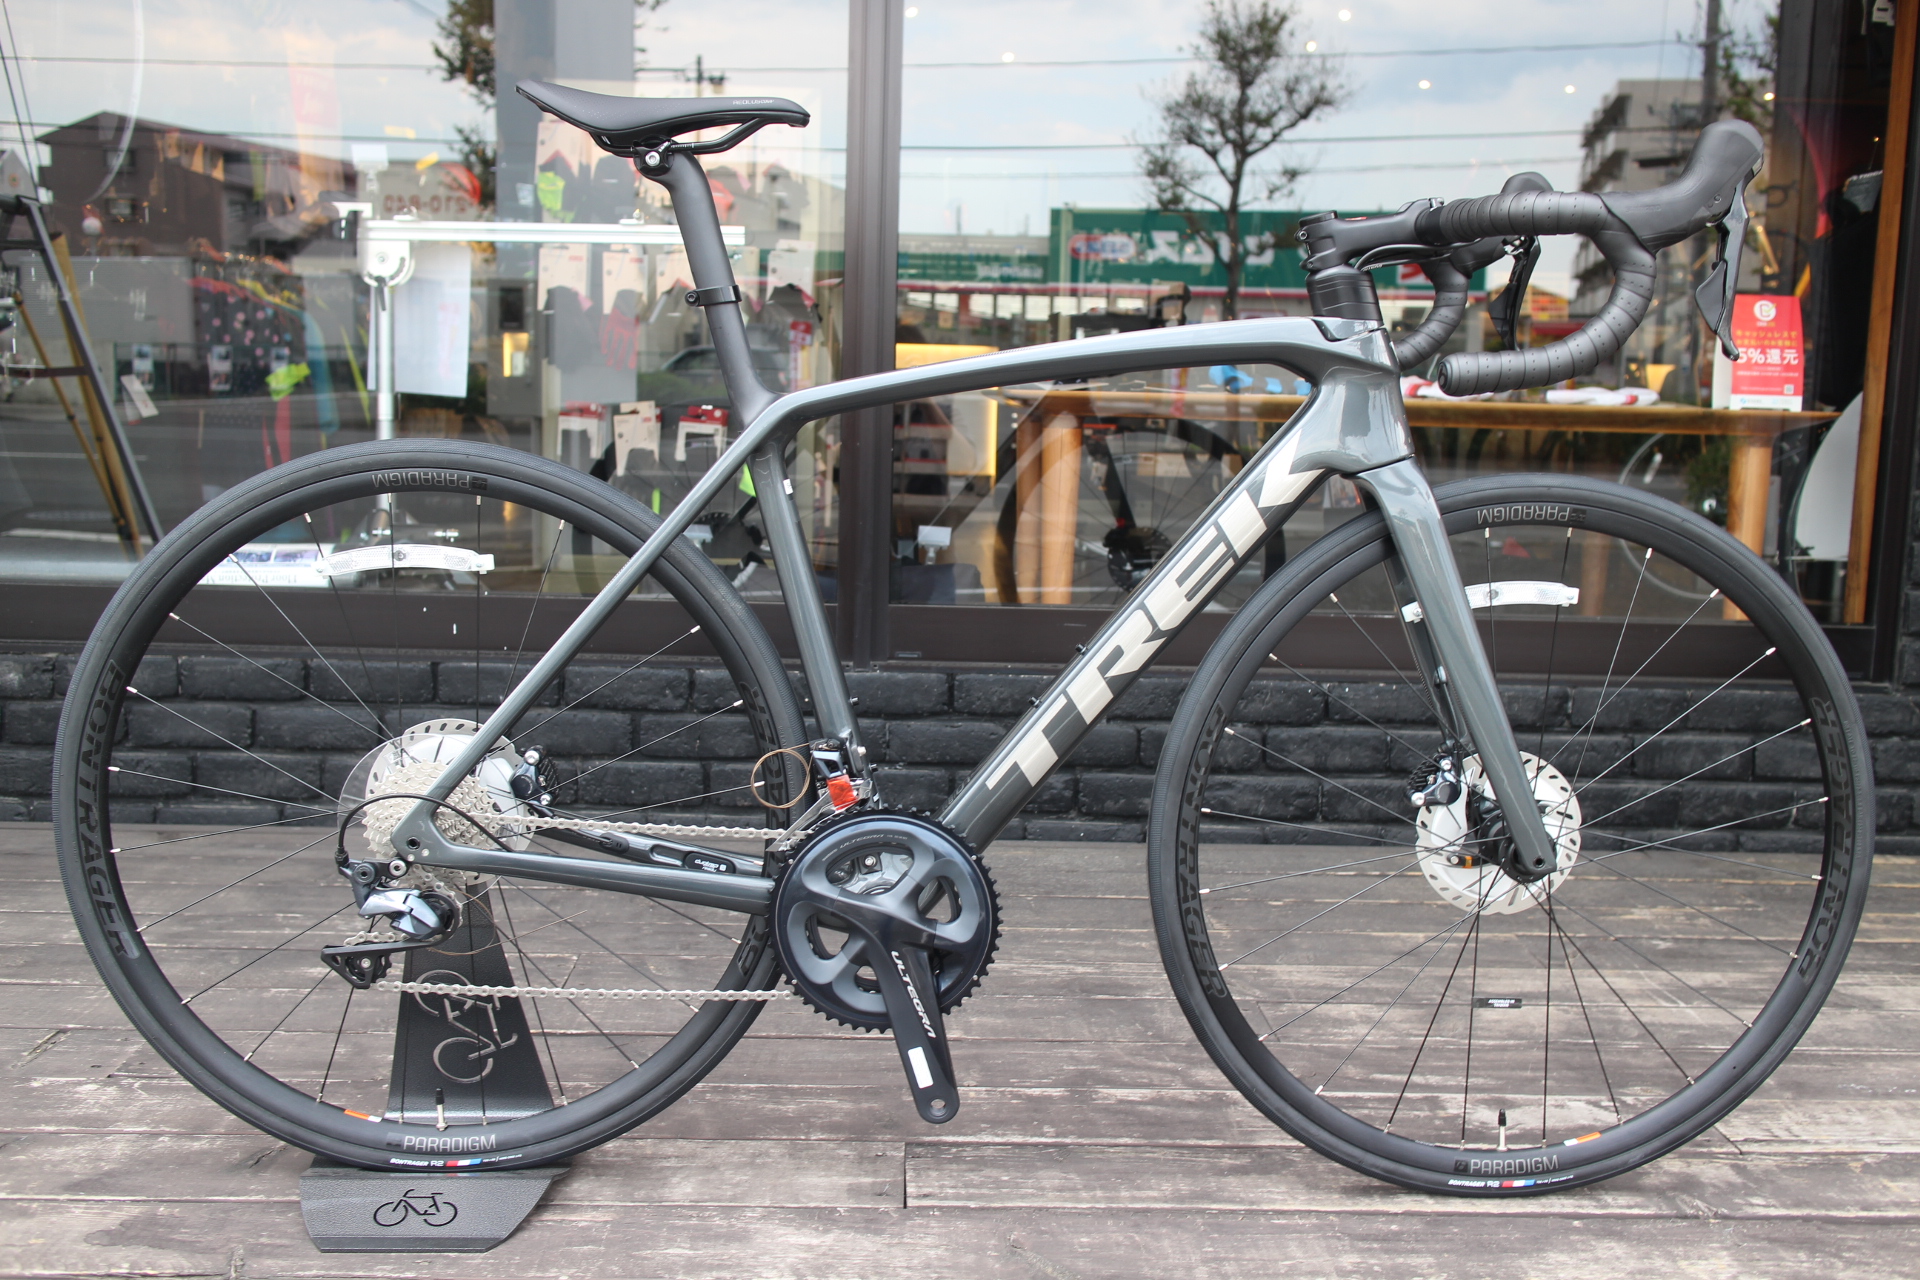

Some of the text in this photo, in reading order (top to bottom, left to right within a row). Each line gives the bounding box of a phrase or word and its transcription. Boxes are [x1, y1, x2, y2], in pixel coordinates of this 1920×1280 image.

[1737, 347, 1799, 365] 5%還元
[371, 471, 470, 488] PARADIGM
[1477, 505, 1570, 525] PARADIGM
[985, 428, 1326, 788] TREK
[77, 658, 140, 960] BONTRAGER
[1179, 702, 1228, 998] BONTRAGER
[1797, 696, 1852, 987] BONTRAGER
[891, 950, 937, 1038] ULTEGRA
[403, 1133, 497, 1152] PARADIGM
[389, 1157, 429, 1167] BONTRAGER
[1469, 1155, 1559, 1175] PARADIGM
[1448, 1179, 1500, 1188] BONTRAGER R2
